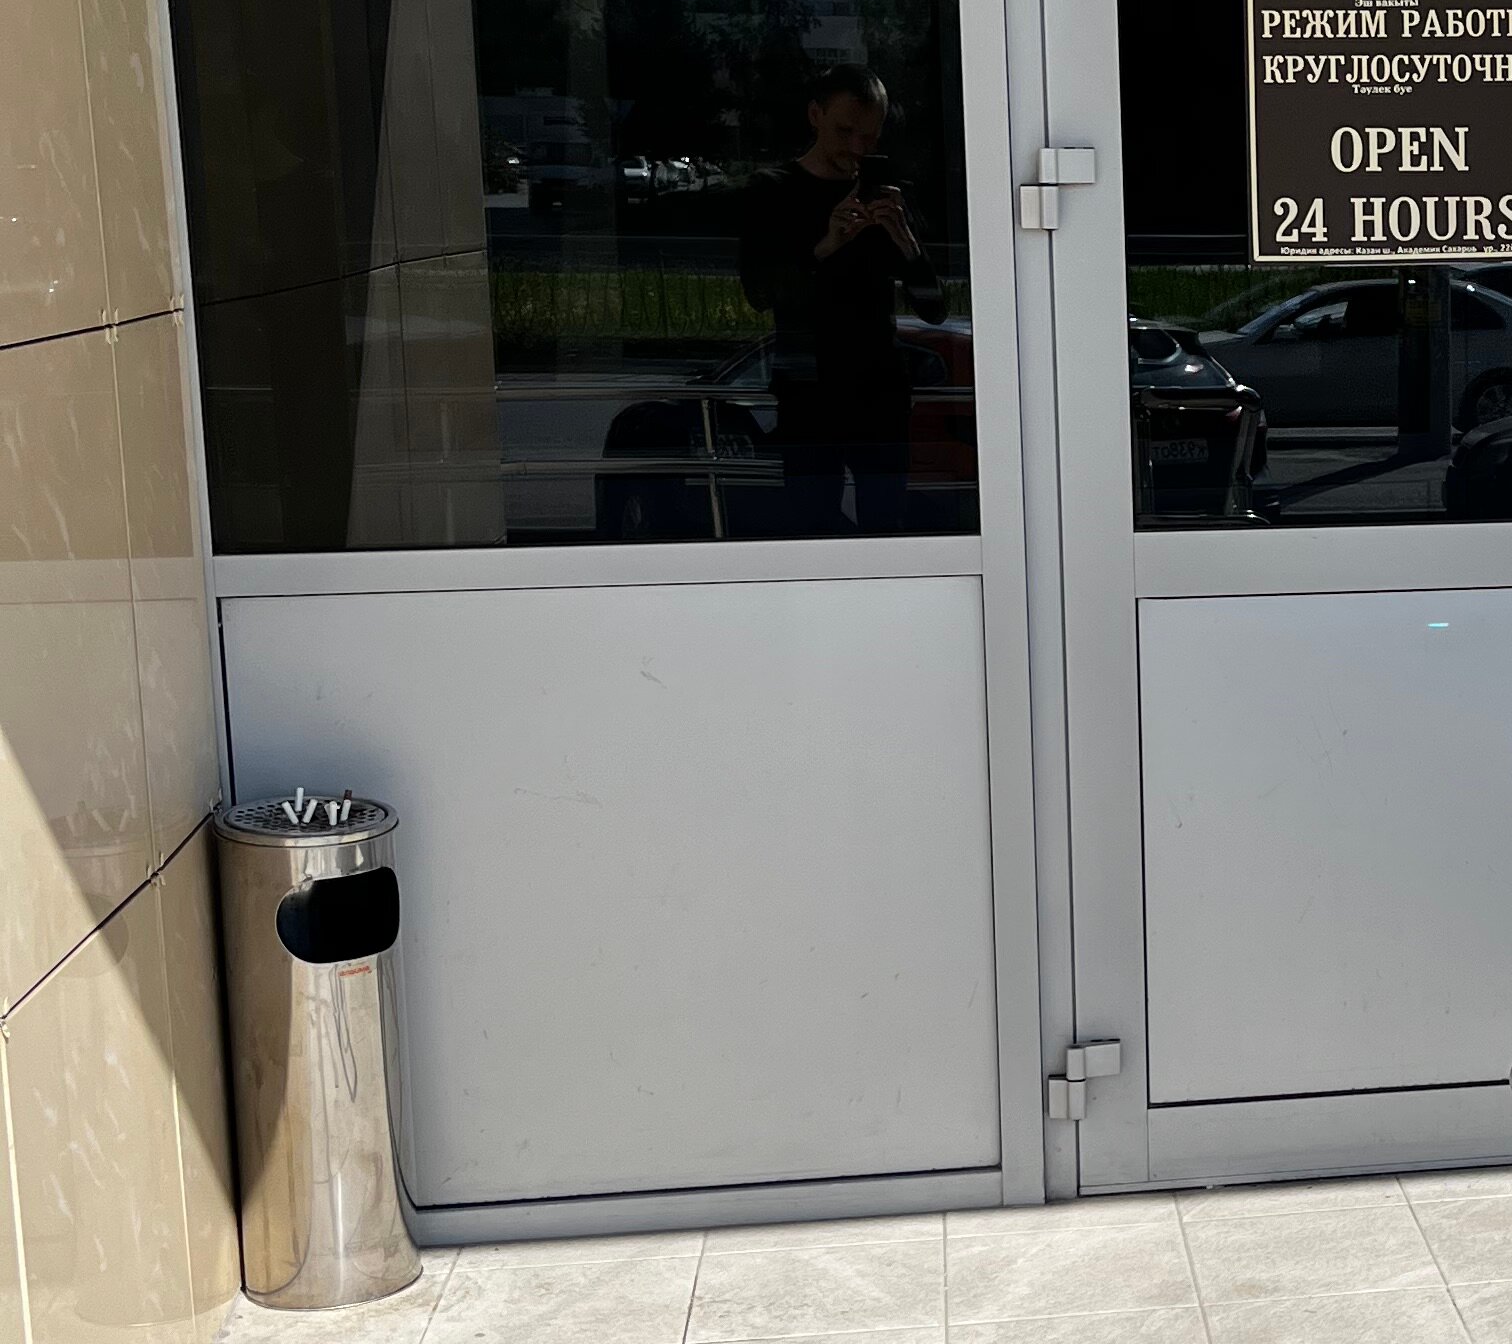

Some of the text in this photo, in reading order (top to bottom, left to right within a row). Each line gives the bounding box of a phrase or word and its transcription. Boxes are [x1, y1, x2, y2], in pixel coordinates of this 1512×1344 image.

[1375, 0, 1419, 7] вакыты
[1261, 9, 1388, 38] РЕЖИМ
[1330, 126, 1469, 173] OPEN
[1273, 197, 1328, 243] 24
